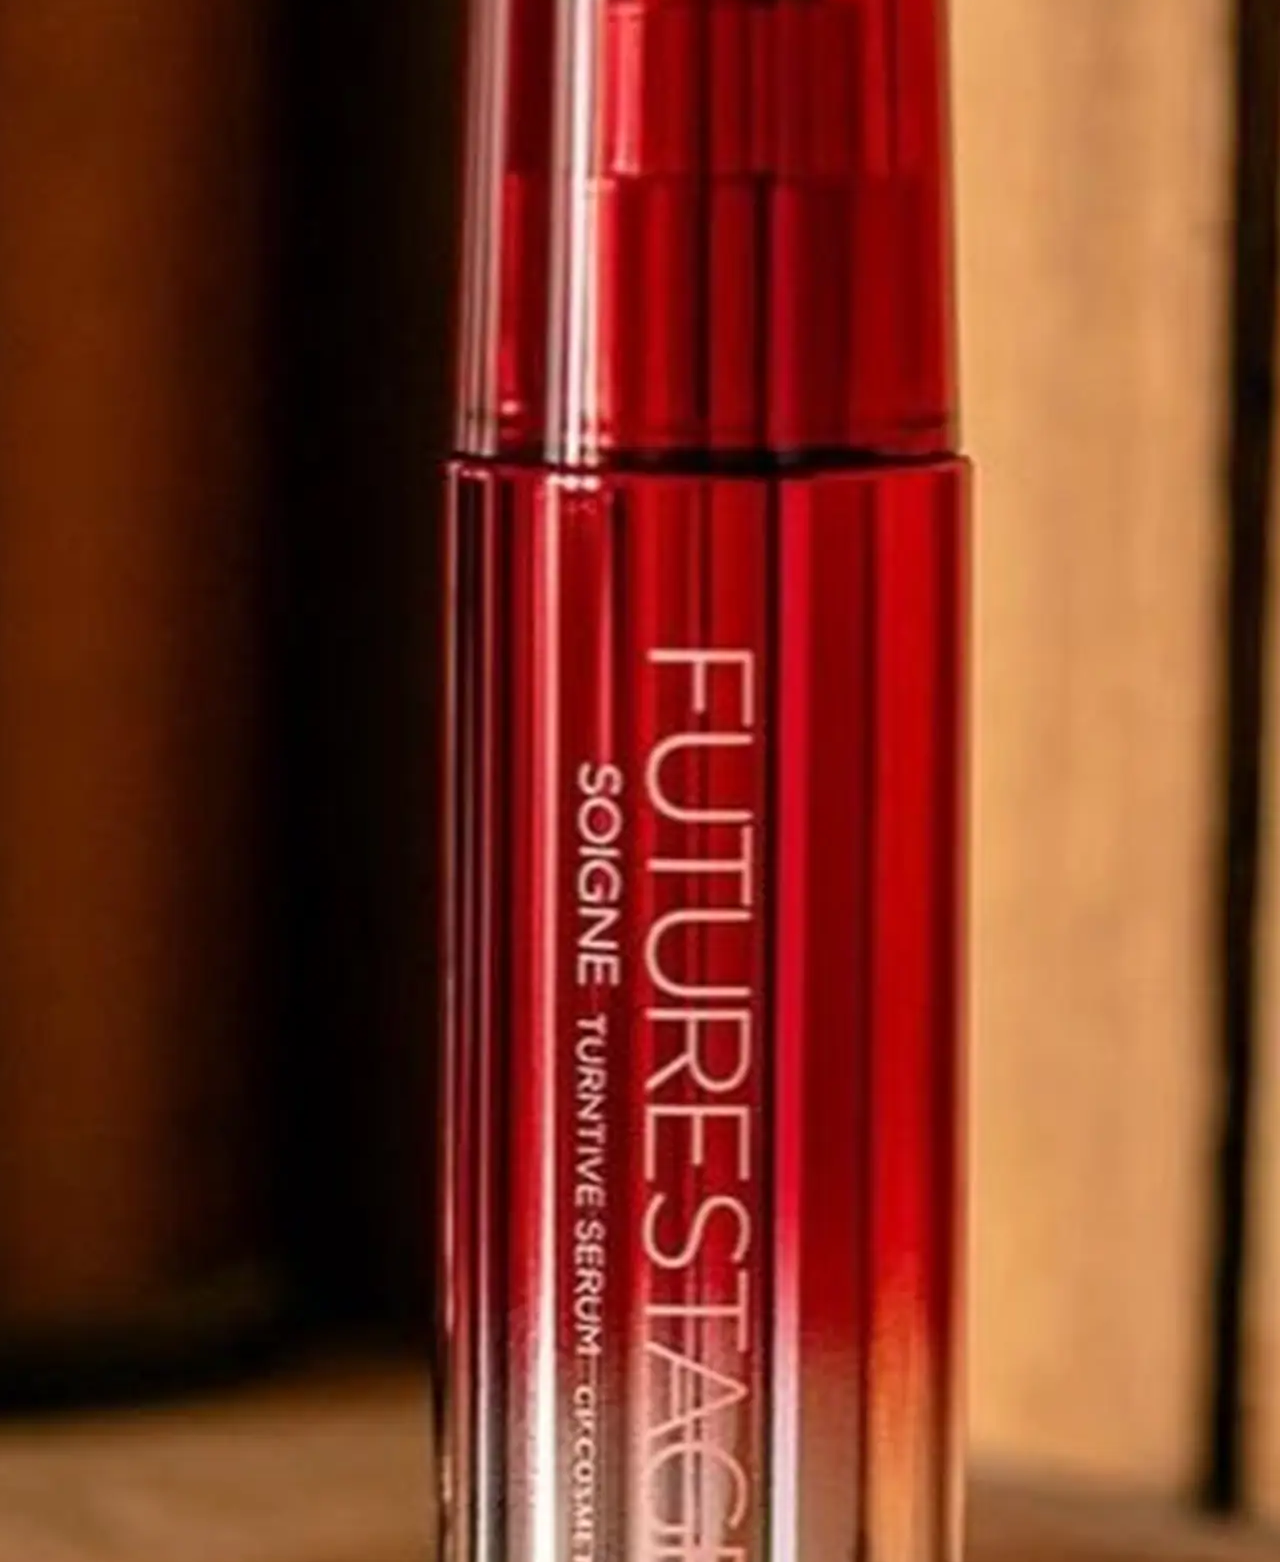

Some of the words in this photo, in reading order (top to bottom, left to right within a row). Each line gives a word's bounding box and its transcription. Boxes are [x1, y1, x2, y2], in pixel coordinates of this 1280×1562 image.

[576, 760, 620, 986] SOIGNE
[573, 1013, 608, 1207] TURNTIVE
[573, 1216, 605, 1356] SERUM
